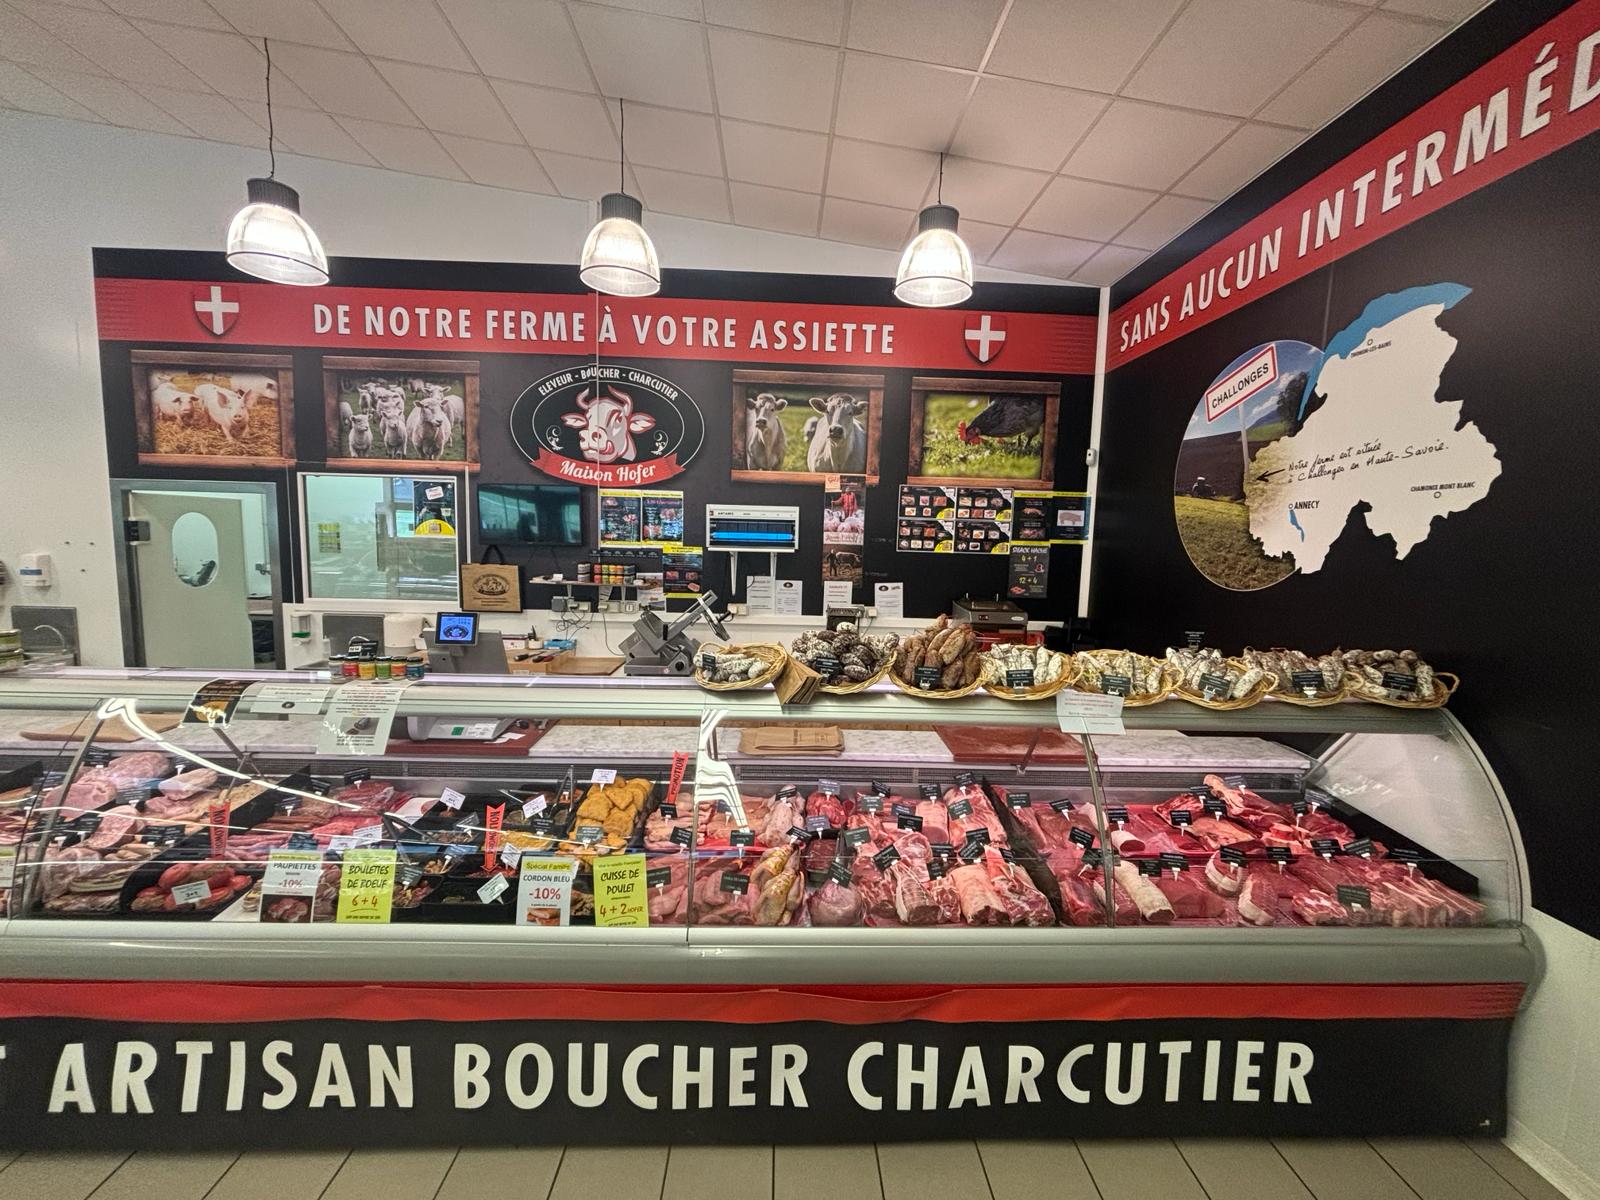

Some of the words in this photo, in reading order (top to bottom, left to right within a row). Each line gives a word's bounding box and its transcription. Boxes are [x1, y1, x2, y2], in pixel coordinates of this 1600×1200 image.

[1119, 296, 1171, 353] SANS
[1178, 226, 1284, 322] AUCUN
[1298, 30, 1600, 258] INTERMÉD
[313, 303, 351, 335] DE
[364, 305, 472, 339] NOTRE
[485, 309, 586, 343] FERME
[598, 305, 618, 344] À
[631, 313, 737, 349] VOTRE
[749, 319, 895, 355] ASSIETTE
[537, 373, 574, 396] ELEVEUR
[580, 367, 620, 379] BOUCHER
[628, 371, 679, 401] CHARCUTIER
[1211, 363, 1270, 410] CHALLONGES
[1288, 459, 1308, 472] Notre
[1311, 453, 1335, 473] ferme
[1339, 446, 1353, 460] est
[559, 460, 613, 482] Maison
[616, 463, 656, 485] Hofer
[1297, 464, 1345, 481] Challonges
[1294, 500, 1320, 510] ANNECY
[348, 863, 390, 875] BOULETTES
[600, 869, 627, 882] CUISSE
[629, 868, 640, 879] DE
[346, 878, 358, 889] DE
[523, 874, 552, 883] CORDON
[553, 874, 571, 883] BLEU
[529, 887, 561, 901] -10%
[606, 883, 635, 896] POULET
[351, 895, 358, 907] 6
[361, 897, 369, 905] +
[371, 895, 379, 908] 4
[599, 904, 607, 918] 4
[609, 904, 618, 914] +
[47, 1040, 414, 1114] ARTISAN
[453, 1042, 809, 1110] BOUCHER
[847, 1040, 1315, 1111] CHARCUTIER
